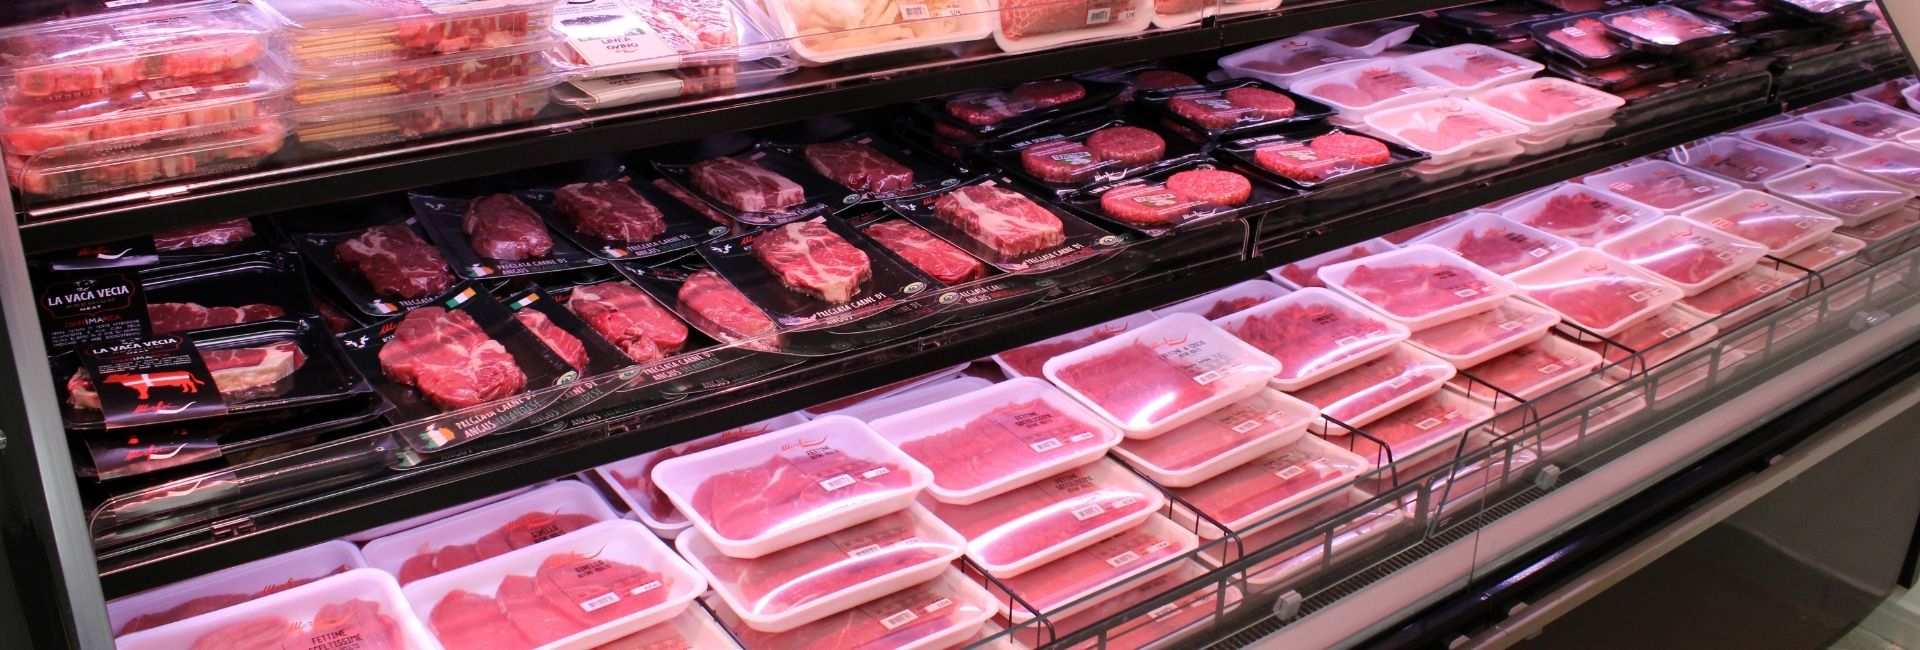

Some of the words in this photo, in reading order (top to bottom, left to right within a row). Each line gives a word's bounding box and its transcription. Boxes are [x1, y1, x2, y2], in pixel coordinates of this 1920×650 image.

[496, 260, 532, 270] PREGIATA
[532, 258, 557, 267] CARNE
[48, 297, 63, 307] LA
[65, 290, 95, 304] VACA
[97, 285, 130, 299] VECIA
[852, 296, 877, 309] CARNE
[875, 292, 887, 301] DI
[92, 347, 108, 355] LA
[110, 342, 141, 353] VACA
[143, 337, 178, 347] VECIA
[644, 360, 680, 375] PREGIATA
[652, 369, 682, 381] ANGUS
[588, 380, 599, 390] DI
[455, 410, 497, 431] PREGIATA
[496, 398, 525, 413] CARNE
[571, 413, 602, 426] ANGUS
[464, 421, 497, 439] ANGUS
[574, 559, 605, 574] GIRELLO
[311, 629, 347, 645] FETTINE
